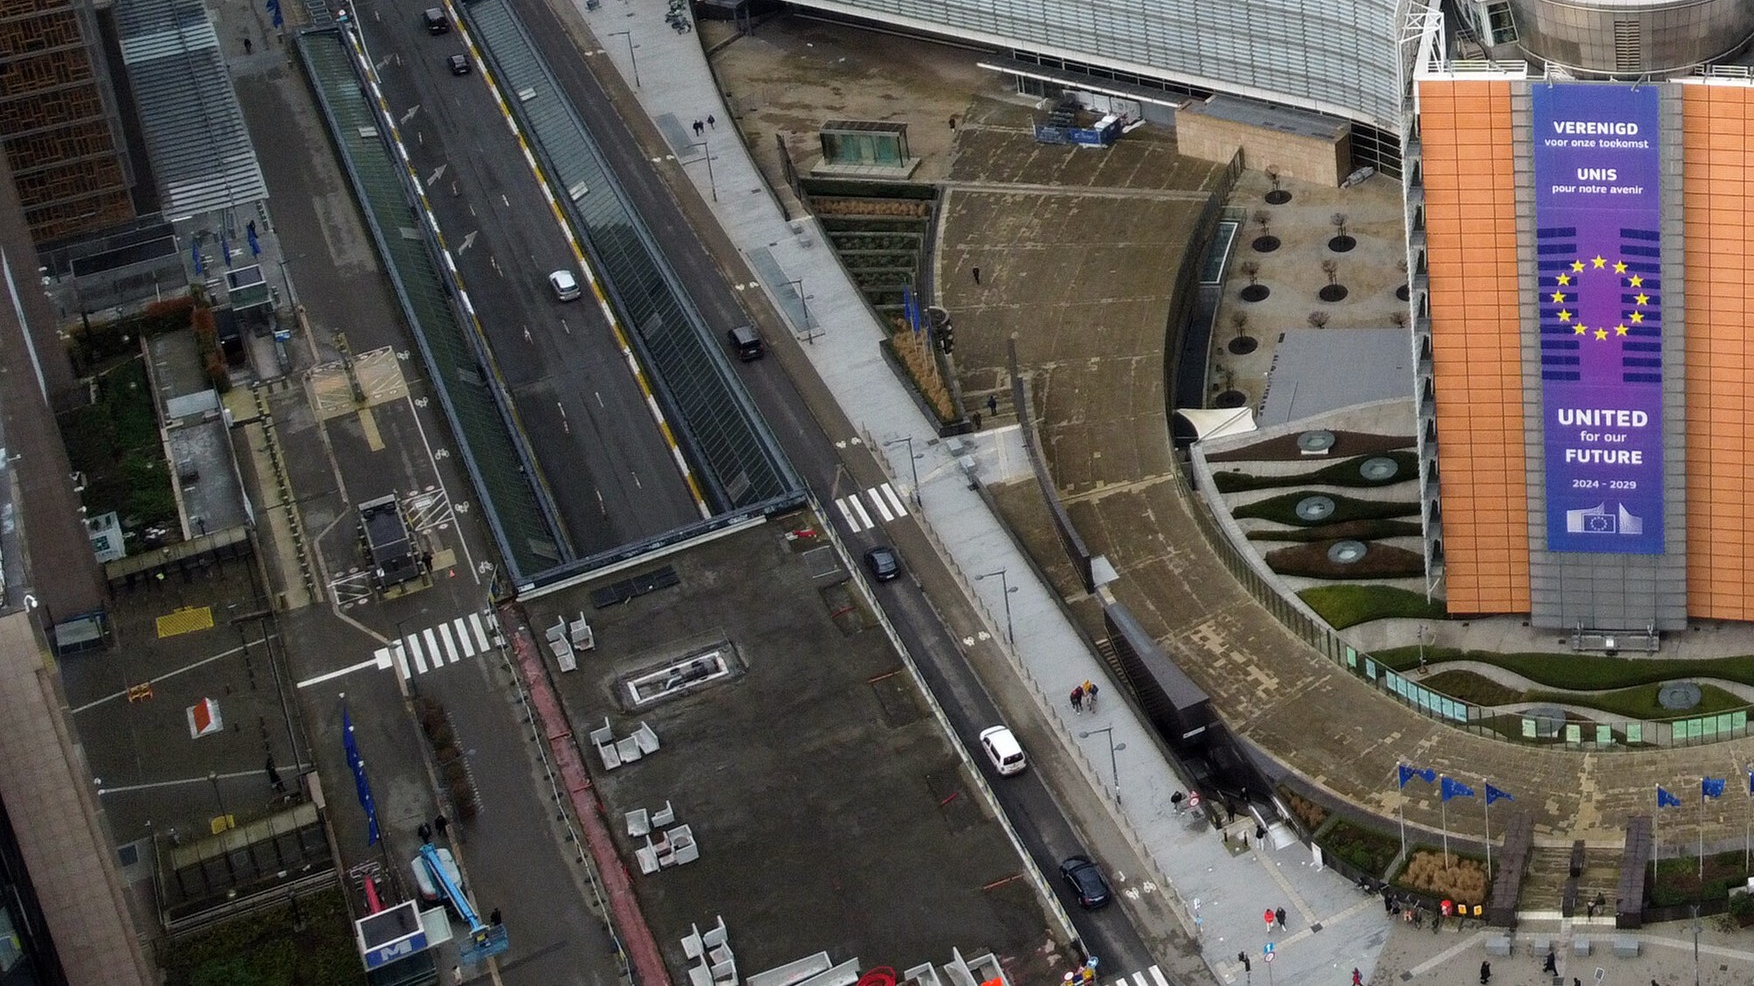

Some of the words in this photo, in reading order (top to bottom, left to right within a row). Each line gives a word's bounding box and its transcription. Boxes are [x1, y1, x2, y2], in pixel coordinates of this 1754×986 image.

[1553, 121, 1639, 135] VERENIGD
[1545, 139, 1568, 147] voor
[1571, 139, 1596, 147] onze
[1599, 139, 1649, 148] toekomst
[1577, 168, 1618, 181] UNIS
[1552, 185, 1576, 194] pour
[1579, 185, 1608, 193] notre
[1610, 185, 1644, 194] avenir
[1558, 408, 1648, 427] UNITED
[1580, 430, 1600, 442] for
[1604, 433, 1627, 443] our
[1565, 449, 1643, 464] FUTURE
[1572, 479, 1599, 488] 2024
[1609, 480, 1637, 489] 2029
[380, 939, 413, 962] M
